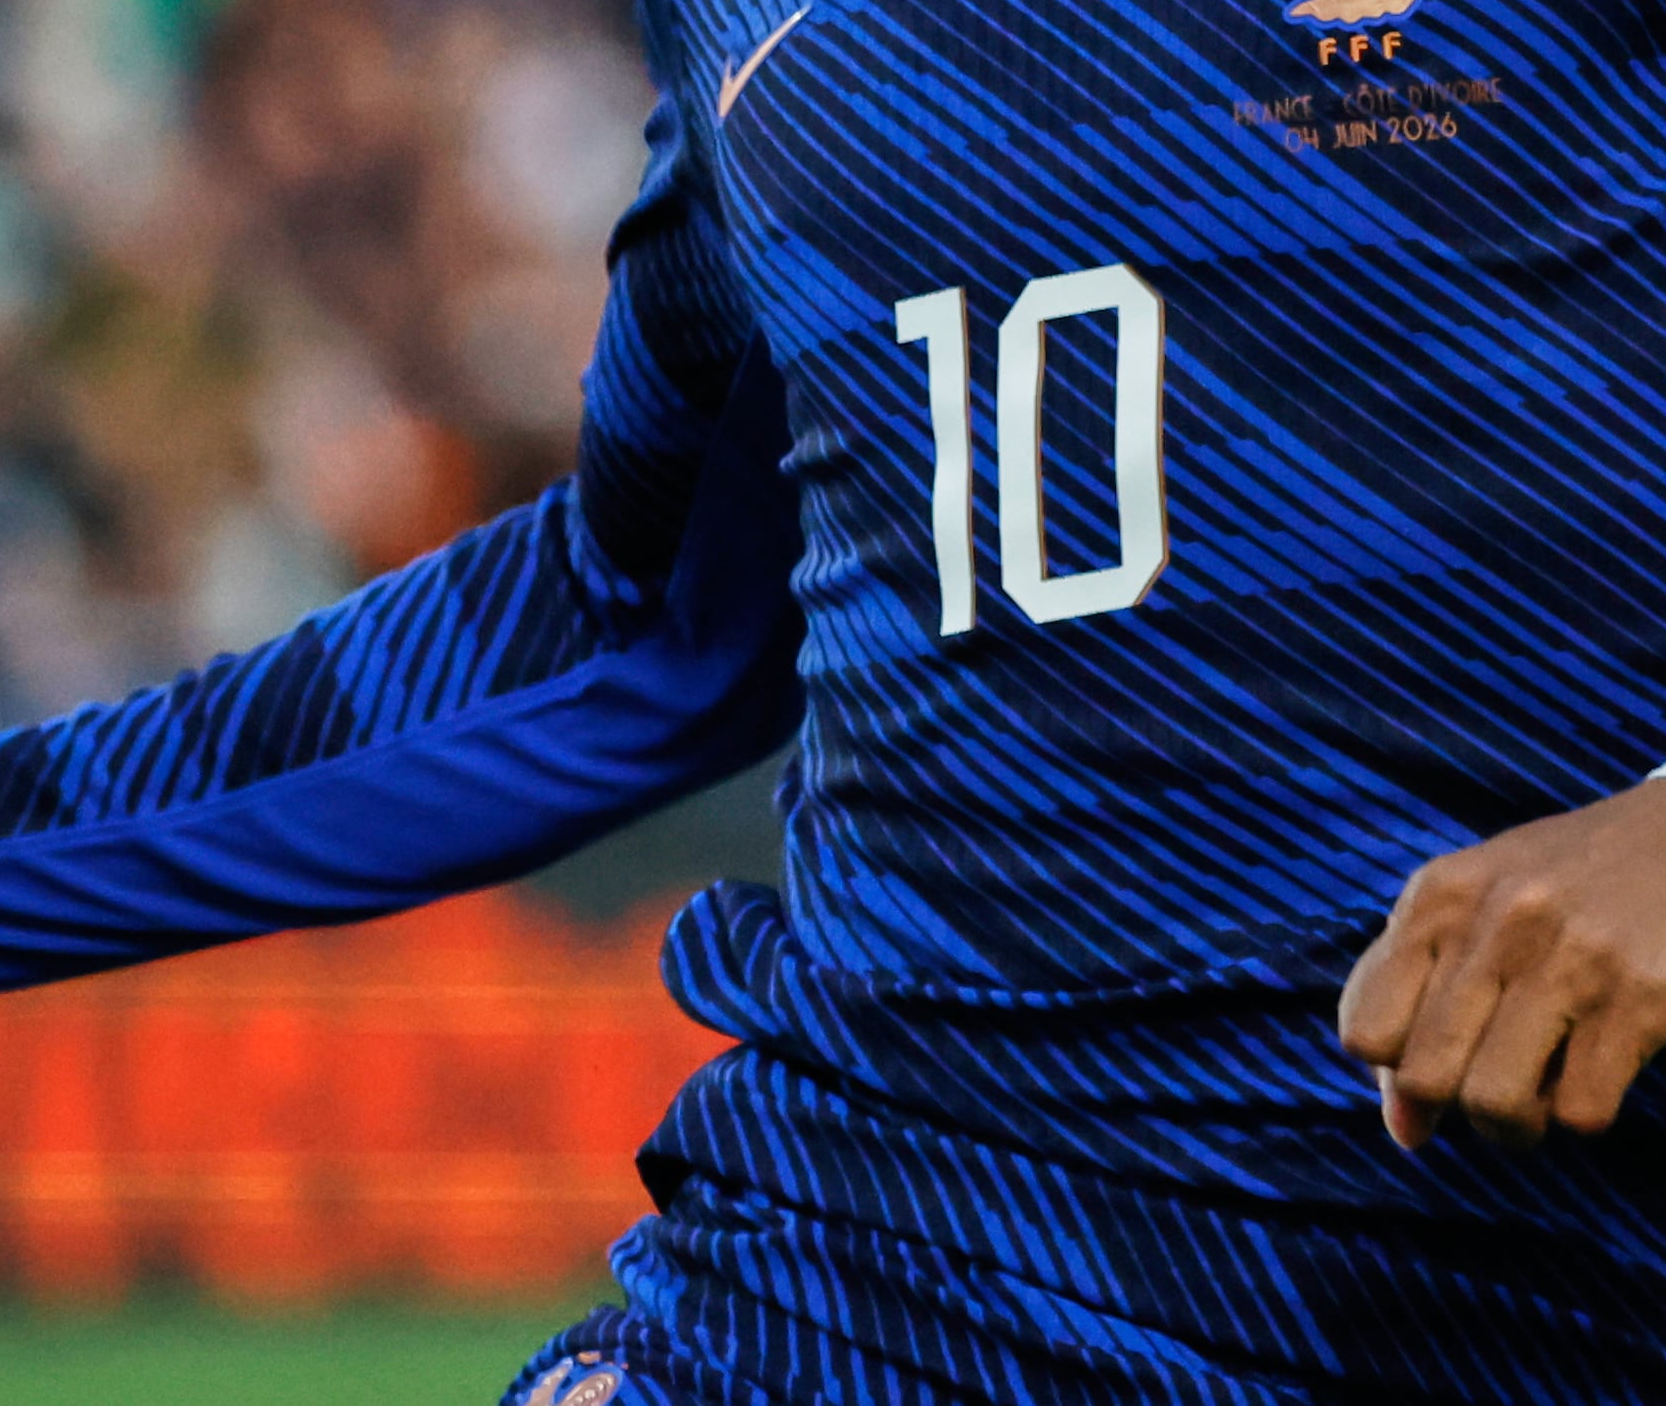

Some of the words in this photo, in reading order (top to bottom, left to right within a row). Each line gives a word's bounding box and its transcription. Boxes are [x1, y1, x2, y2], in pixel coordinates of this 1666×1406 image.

[1233, 95, 1313, 126] FRANCE
[1284, 128, 1320, 154] 04
[1332, 120, 1378, 149] JUIN
[1386, 111, 1458, 144] 2026
[894, 263, 1169, 637] 10
